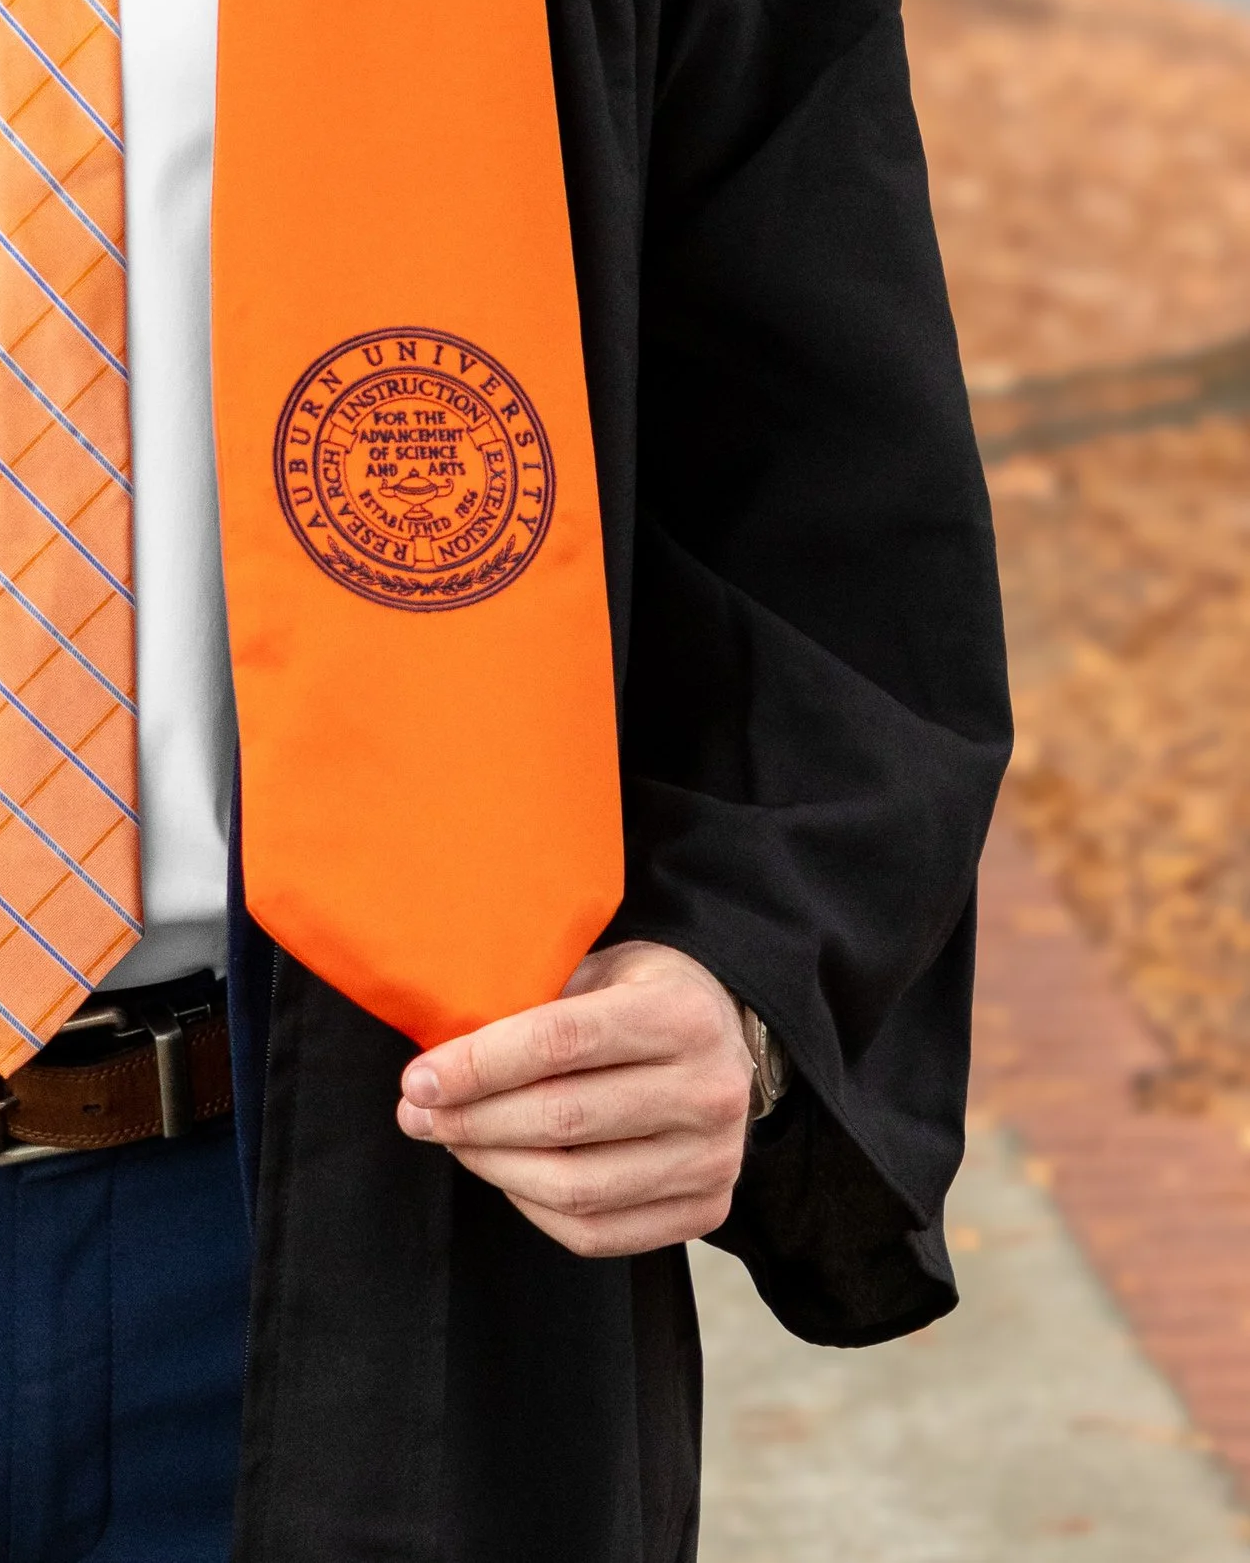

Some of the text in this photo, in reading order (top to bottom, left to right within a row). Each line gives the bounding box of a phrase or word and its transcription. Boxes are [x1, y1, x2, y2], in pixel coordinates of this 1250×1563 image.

[338, 377, 486, 424] INSTRUCTION
[373, 410, 447, 425] FOR THE
[289, 341, 543, 535] AUBURN UNIVERSITY
[359, 428, 465, 444] ADVANCEMENT
[369, 446, 458, 461] OF SCIENCE
[365, 462, 467, 478] AND ARTS
[322, 449, 408, 562] RESEARCH
[359, 490, 452, 535] ESTABLISHED
[438, 449, 507, 562] EXTENSION
